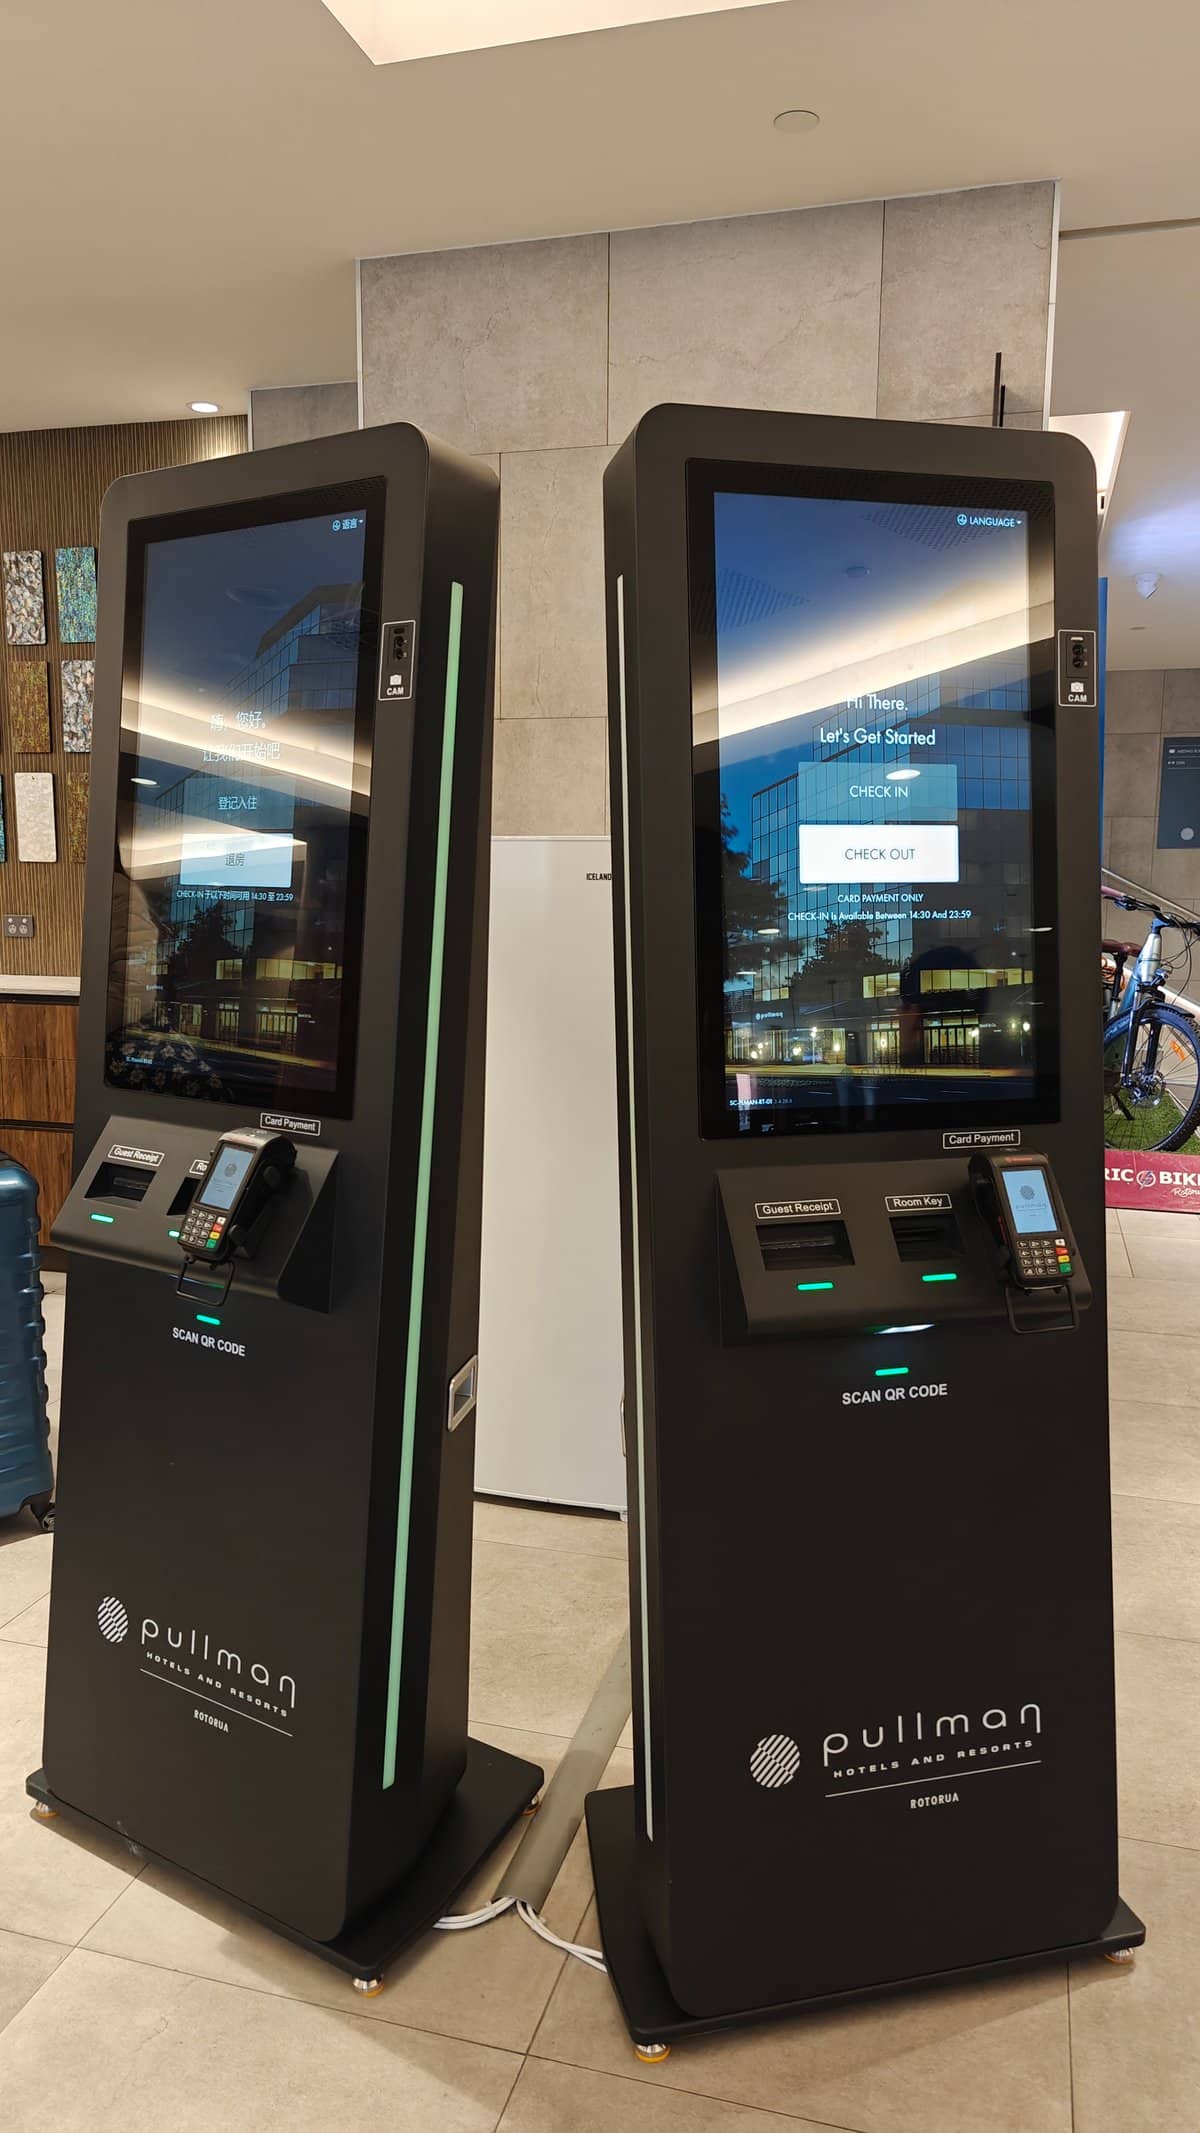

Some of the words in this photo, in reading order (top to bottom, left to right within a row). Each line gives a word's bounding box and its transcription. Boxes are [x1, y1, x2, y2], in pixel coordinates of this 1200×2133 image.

[342, 518, 358, 529] 语言
[969, 516, 1015, 527] LANGUAGE
[386, 687, 404, 696] CAM
[1068, 694, 1087, 703] CAM
[847, 695, 862, 709] Hi
[867, 693, 908, 711] There.
[820, 727, 850, 743] Let's
[854, 728, 881, 743] Get
[885, 729, 936, 745] Started
[849, 785, 892, 798] CHECK
[894, 785, 909, 798] IN
[218, 795, 257, 810] 登记入住
[225, 853, 245, 867] 退房
[844, 848, 887, 860] CHECK
[889, 848, 916, 860] OUT
[176, 890, 204, 899] CHECK-IN
[837, 894, 861, 903] CARD
[862, 894, 899, 903] PAYMENT
[901, 893, 924, 903] ONLY
[787, 912, 829, 921] CHECK-IN
[831, 911, 837, 921] Is
[838, 911, 874, 921] Available
[875, 911, 907, 920] Between
[909, 910, 931, 920] 14:30
[932, 910, 948, 919] And
[949, 909, 972, 919] 23:59
[264, 1115, 283, 1126] Card
[283, 1118, 316, 1131] Payment
[949, 1133, 972, 1145] Card
[974, 1132, 1015, 1146] Payment
[113, 1147, 134, 1158] Guest
[133, 1150, 160, 1163] Receipt
[196, 1162, 208, 1172] Ro
[1160, 1171, 1200, 1186] BIK
[762, 1203, 795, 1216] Guest
[795, 1201, 834, 1215] Receipt
[893, 1197, 921, 1208] Room
[924, 1196, 943, 1208] Key
[172, 1326, 199, 1345] SCAN
[200, 1334, 216, 1349] QR
[217, 1339, 246, 1357] CODE
[842, 1389, 882, 1405] SCAN
[885, 1387, 906, 1402] QR
[908, 1383, 948, 1399] CODE
[141, 1618, 296, 1709] pullman
[146, 1651, 190, 1675] HOTELS
[197, 1673, 222, 1689] AND
[229, 1687, 287, 1717] RESORTS
[193, 1709, 229, 1733] ROTORUA
[823, 1703, 1041, 1767] pullman
[833, 1761, 899, 1778] HOTELS
[911, 1753, 945, 1766] AND
[957, 1740, 1033, 1759] RESORTS
[910, 1792, 959, 1809] ROTORUA
